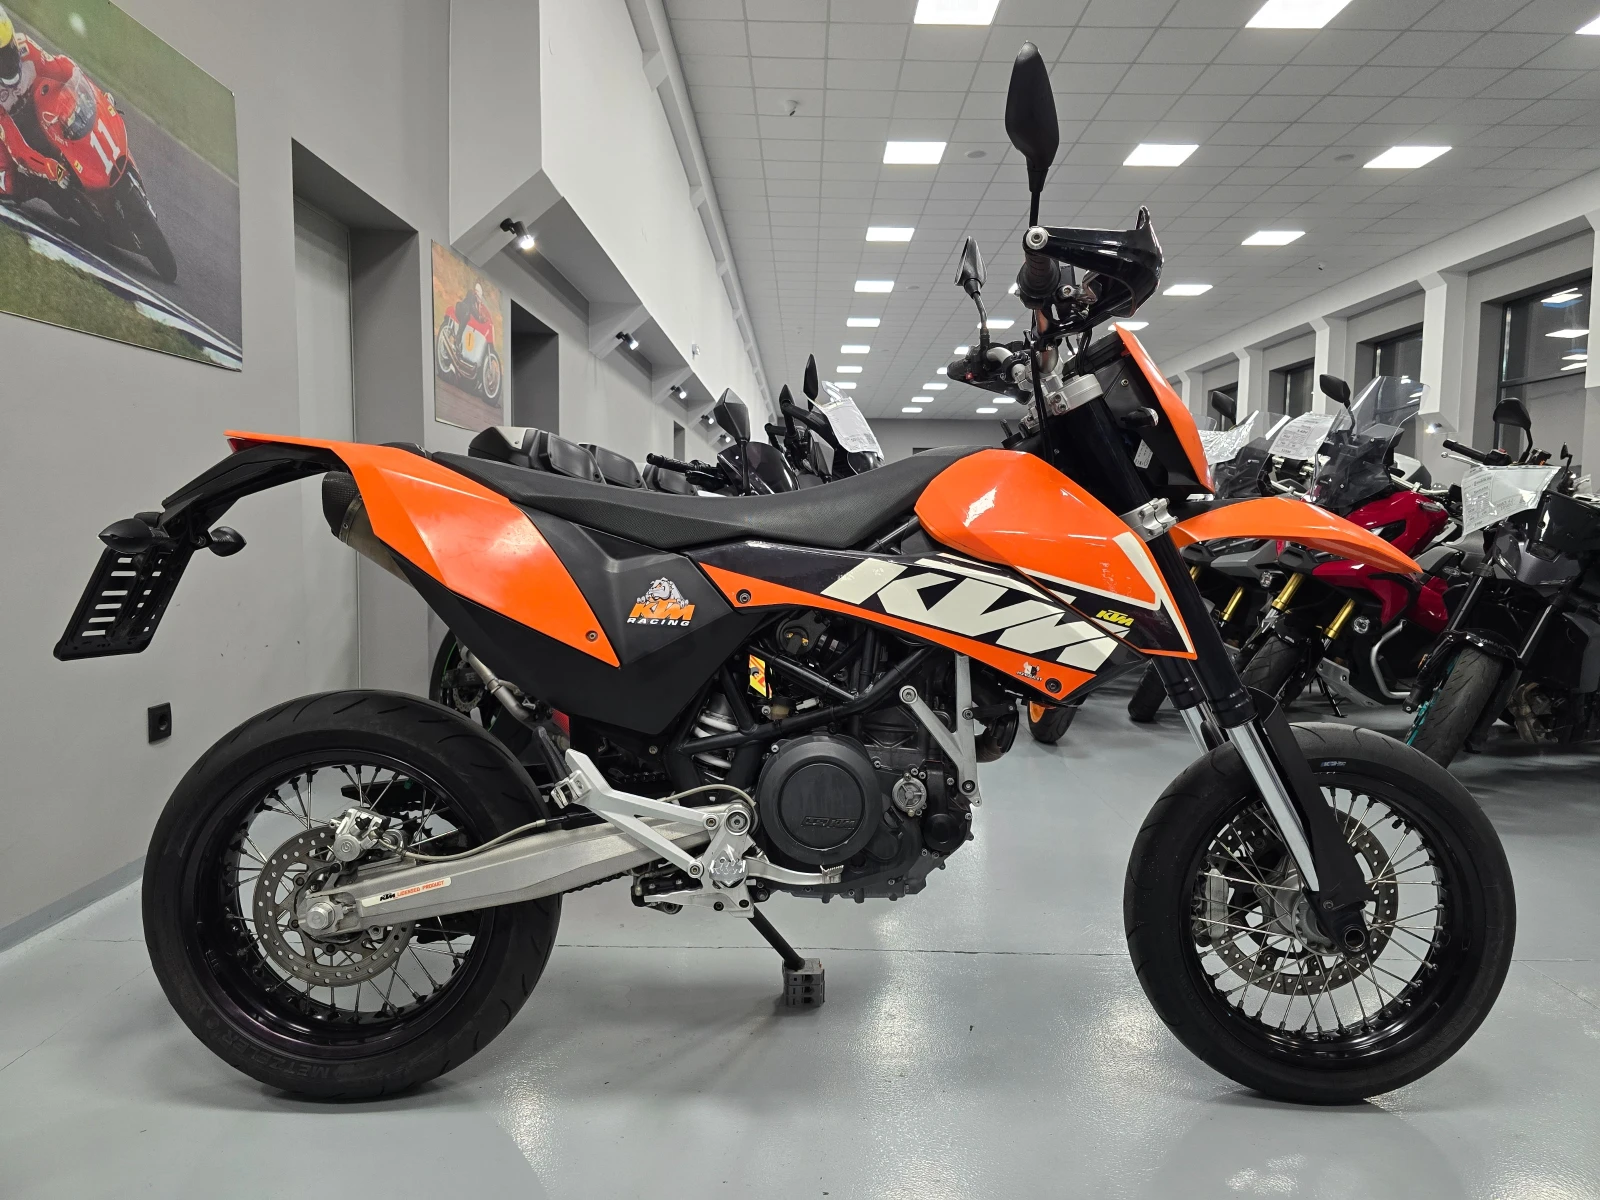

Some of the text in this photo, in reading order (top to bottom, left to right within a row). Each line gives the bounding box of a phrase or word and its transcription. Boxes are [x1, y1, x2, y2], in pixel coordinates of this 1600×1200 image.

[90, 118, 120, 176] 11
[629, 599, 695, 620] KTM
[820, 558, 1119, 671] KTM
[1096, 610, 1134, 626] KTM
[627, 618, 690, 626] RACING
[380, 880, 444, 901] KTM LICENSED PRODUCT
[221, 1030, 331, 1078] METZELER
